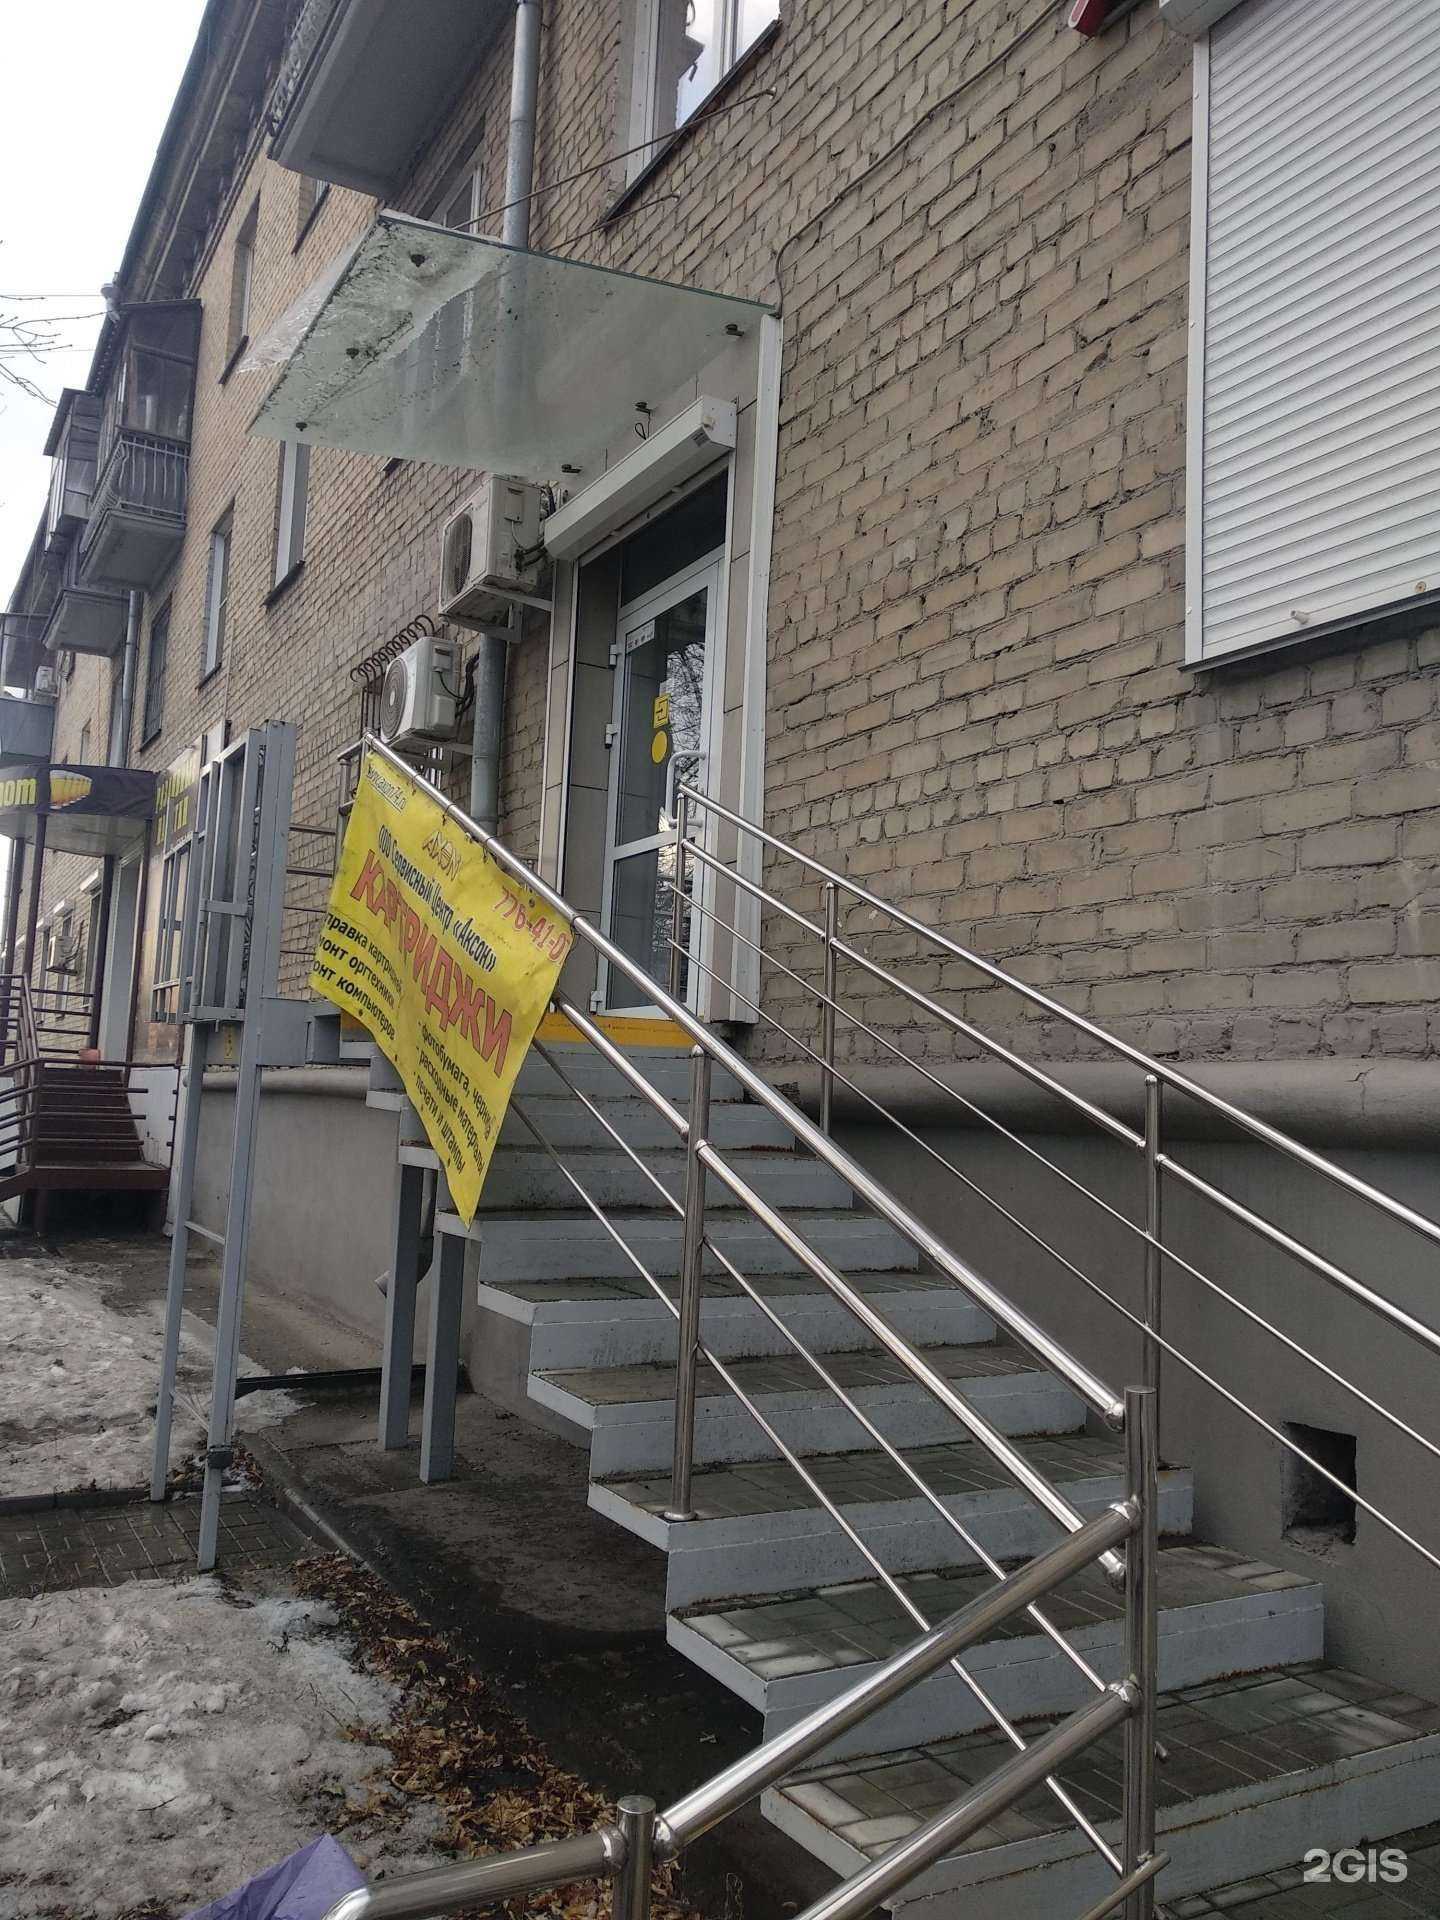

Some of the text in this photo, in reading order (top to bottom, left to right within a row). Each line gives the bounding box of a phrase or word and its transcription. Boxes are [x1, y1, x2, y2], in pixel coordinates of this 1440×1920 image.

[350, 850, 514, 1078] КАРТРИДЖИ
[378, 824, 497, 973] ООО Сервисный Центр «Аксон»
[336, 976, 395, 1040] компьютеров
